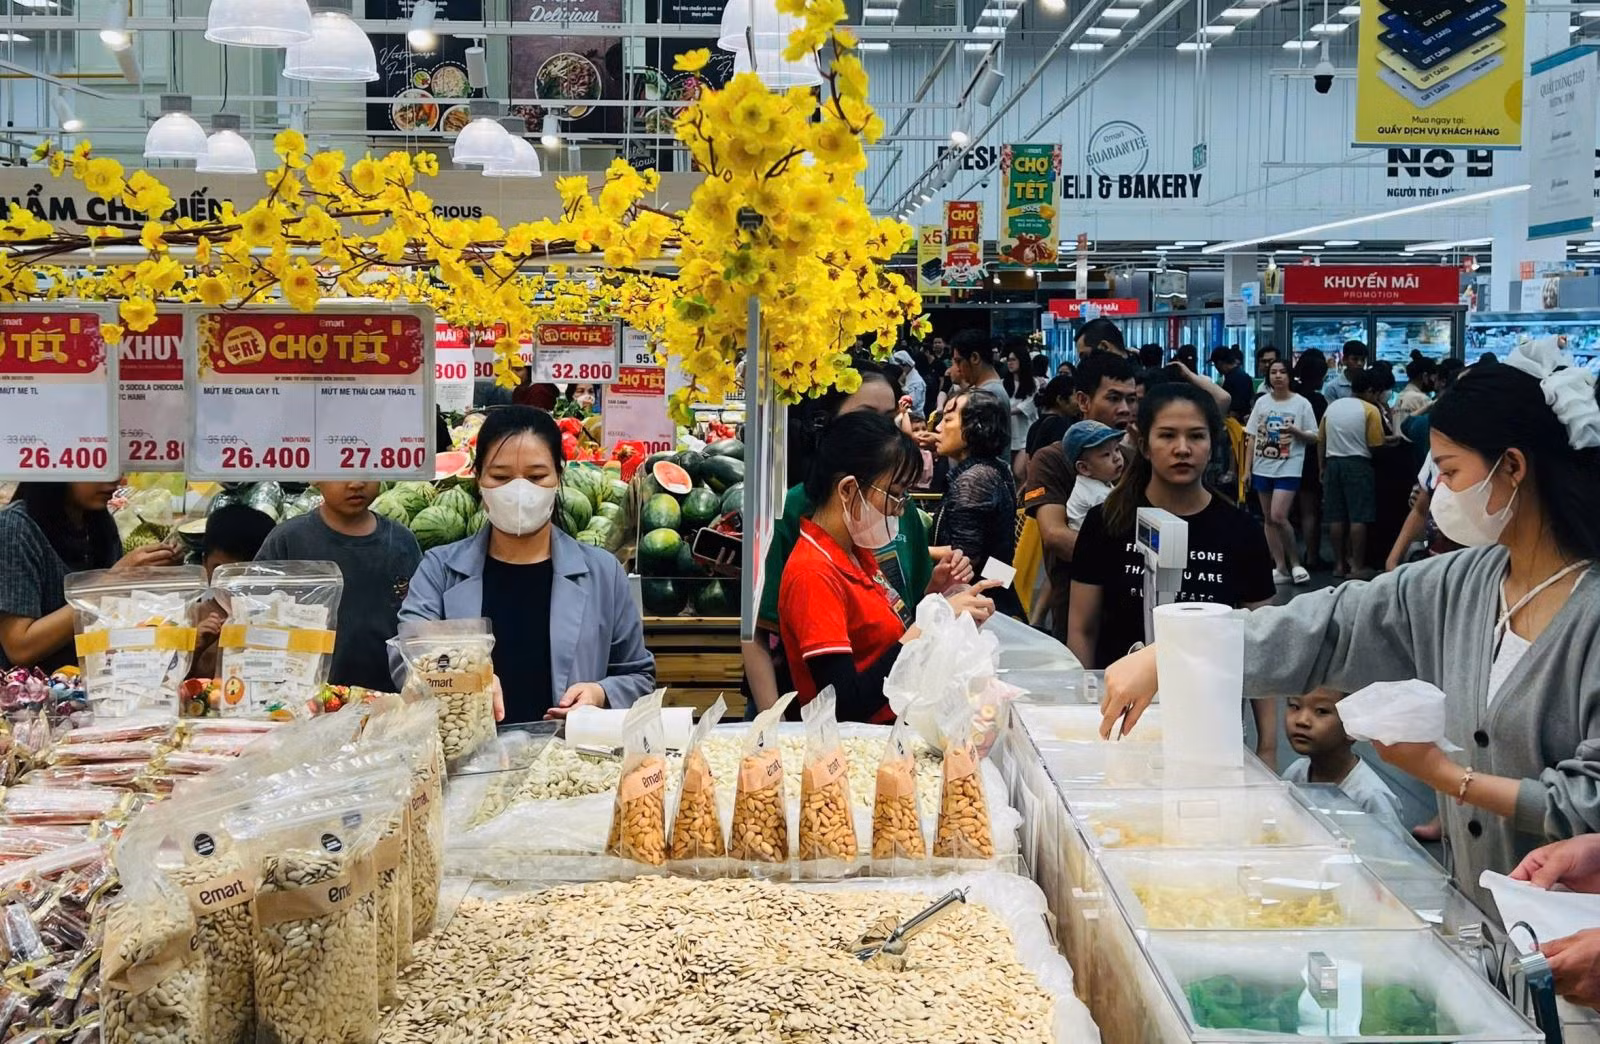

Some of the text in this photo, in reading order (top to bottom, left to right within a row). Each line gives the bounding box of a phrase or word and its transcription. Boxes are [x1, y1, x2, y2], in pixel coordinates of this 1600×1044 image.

[529, 5, 599, 22] Delicious
[1423, 9, 1452, 27] GIFT CARD
[1422, 28, 1452, 45] GIFT CARD
[1422, 47, 1451, 64] GIFT CARD
[1421, 65, 1450, 82] GIFT CARD
[1421, 84, 1450, 101] GIFT CARD
[1431, 117, 1450, 125] ngay
[1404, 127, 1425, 136] DỊCH
[1428, 127, 1440, 136] VỤ
[1442, 125, 1473, 135] KHÁCH
[1086, 135, 1149, 167] GUARANTEE
[1014, 157, 1048, 174] CHỢ
[1014, 179, 1048, 199] TẾT
[1060, 173, 1202, 199] ELI & BAKERY
[1387, 186, 1416, 198] NGƯỜI
[951, 209, 975, 222] CHỢ
[951, 225, 974, 240] TẾT
[1324, 272, 1419, 288] KHUYẾN MÃI
[1343, 291, 1400, 299] PROMOTION
[560, 331, 581, 342] CHỢ
[582, 330, 602, 342] TẾT
[11, 328, 69, 363] TẾT
[269, 329, 390, 364] CHỢ TẾT
[552, 363, 612, 379] 32.800
[642, 373, 665, 388] TẾT
[17, 387, 29, 395] ME
[30, 387, 39, 395] TL
[203, 386, 280, 395] MỨT ME CHUA CAY TL
[321, 386, 338, 395] MỨT
[340, 387, 350, 395] ME
[369, 387, 386, 395] CAM
[407, 387, 416, 395] TL
[19, 447, 108, 469] 26.400
[129, 440, 184, 461] 22.8
[221, 447, 311, 468] 26.400
[340, 447, 426, 468] 27.800
[1198, 572, 1223, 583] ARE
[641, 769, 664, 788] emart
[199, 879, 246, 906] emart
